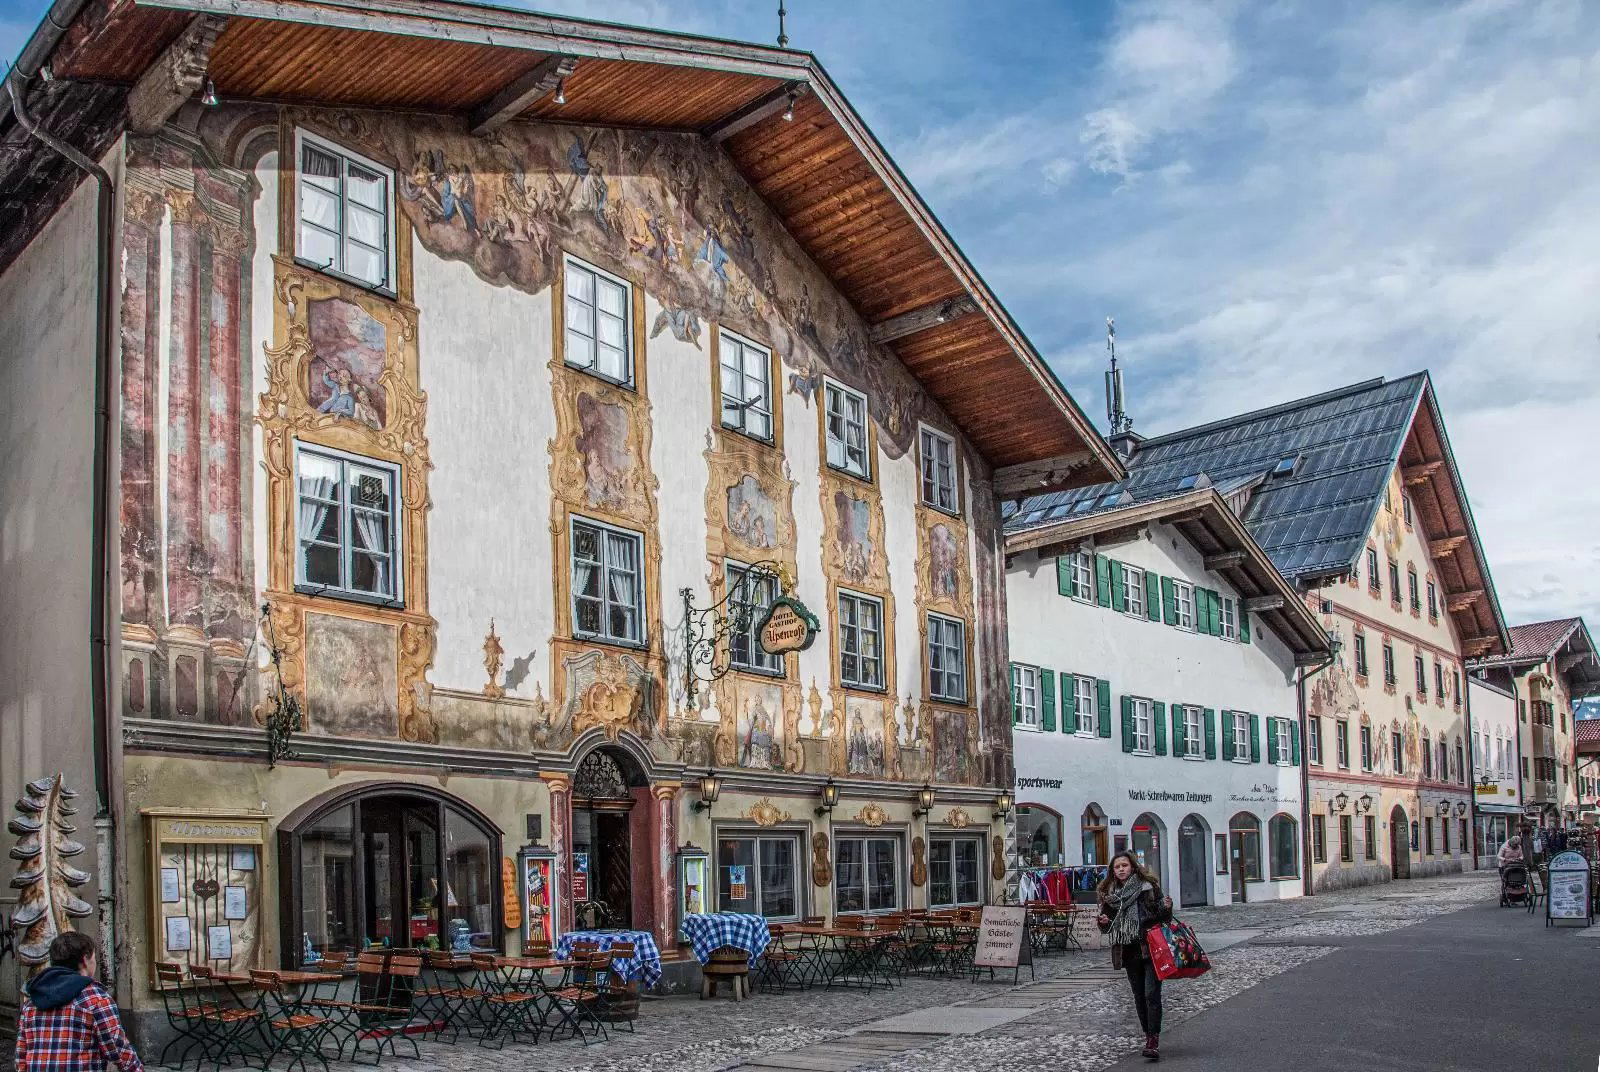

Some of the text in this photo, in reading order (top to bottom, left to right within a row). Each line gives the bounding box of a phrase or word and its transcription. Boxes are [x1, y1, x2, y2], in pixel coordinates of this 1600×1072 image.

[769, 618, 798, 629] GASTHOF
[1017, 777, 1063, 790] sportswear
[1186, 791, 1212, 804] Zeitungen
